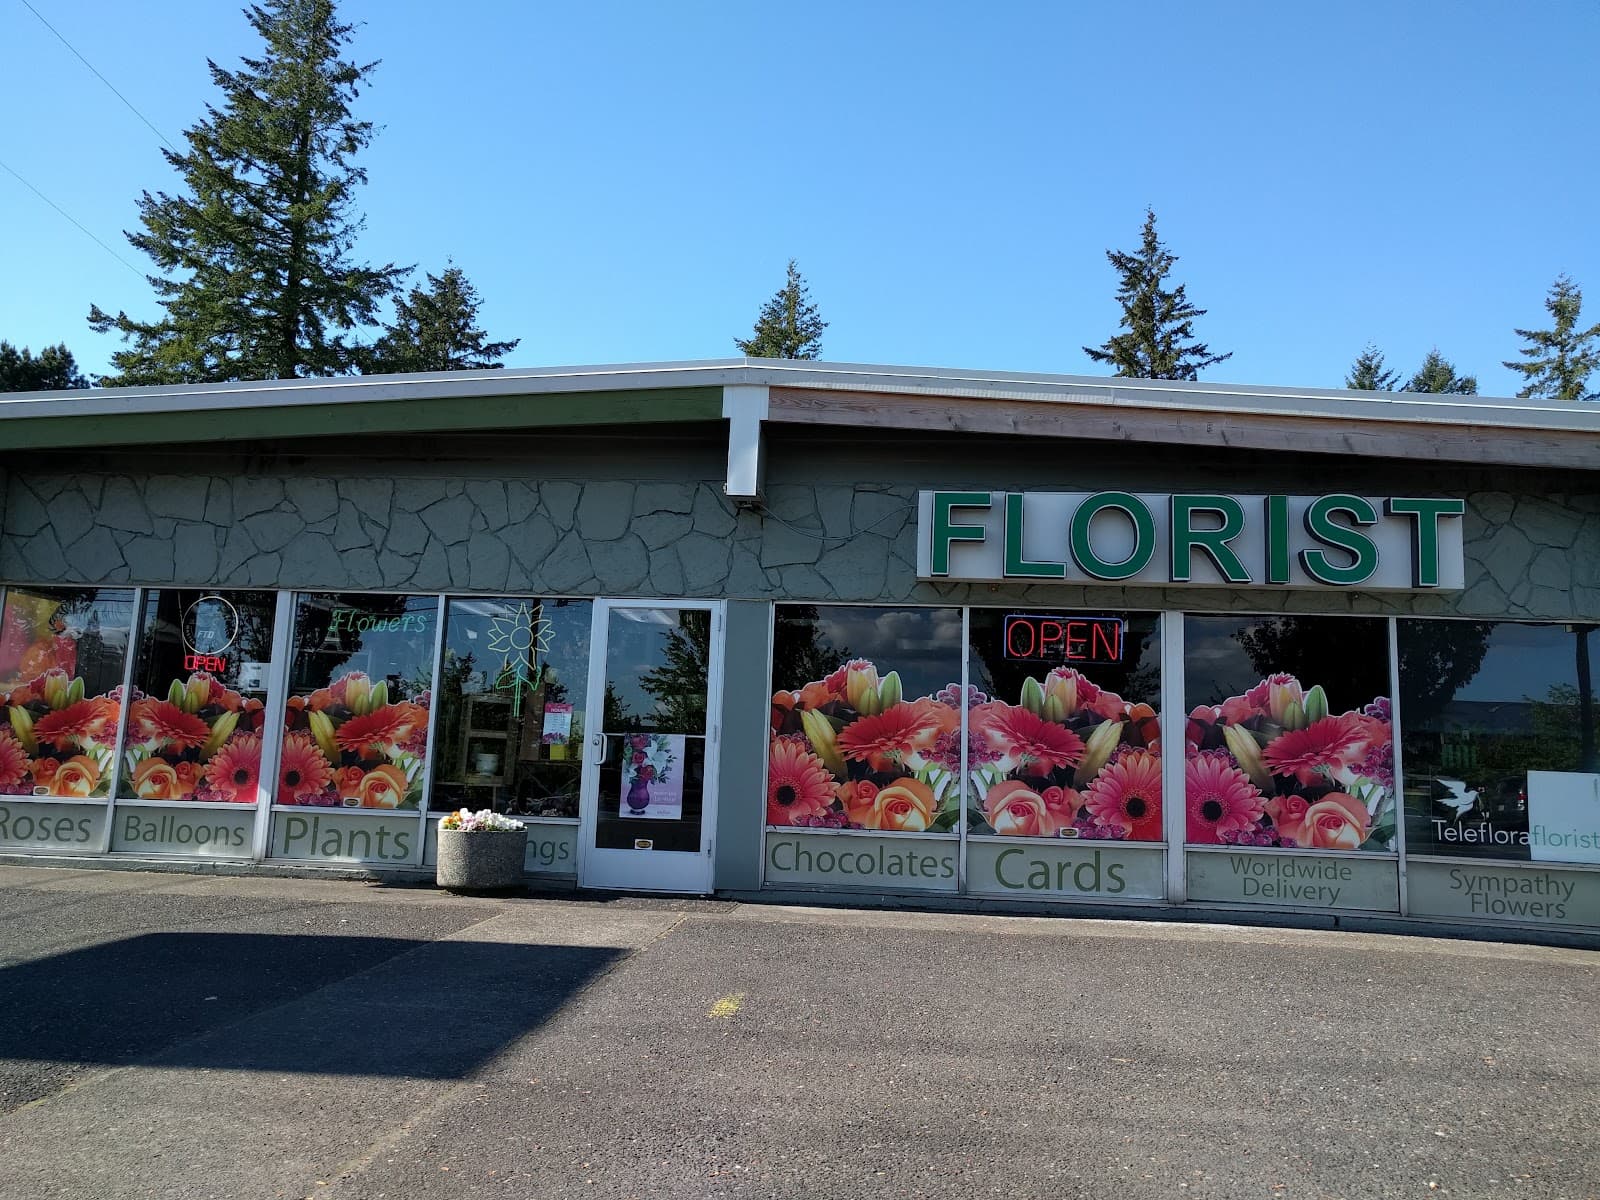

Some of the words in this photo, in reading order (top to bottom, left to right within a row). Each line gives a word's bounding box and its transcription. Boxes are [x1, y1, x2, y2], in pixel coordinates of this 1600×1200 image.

[930, 490, 1465, 588] FLORIST
[328, 608, 428, 633] Flowers
[1007, 620, 1121, 662] OPEN
[184, 655, 227, 673] OPEN
[124, 815, 245, 847] Balloons
[283, 817, 410, 860] Plants
[770, 841, 955, 880] Chocolates
[994, 848, 1126, 894] Cards
[1230, 856, 1353, 881] Worldwide
[1243, 877, 1341, 906] Delivery
[1450, 868, 1576, 902] Sympathy
[1471, 892, 1567, 919] Flowers
